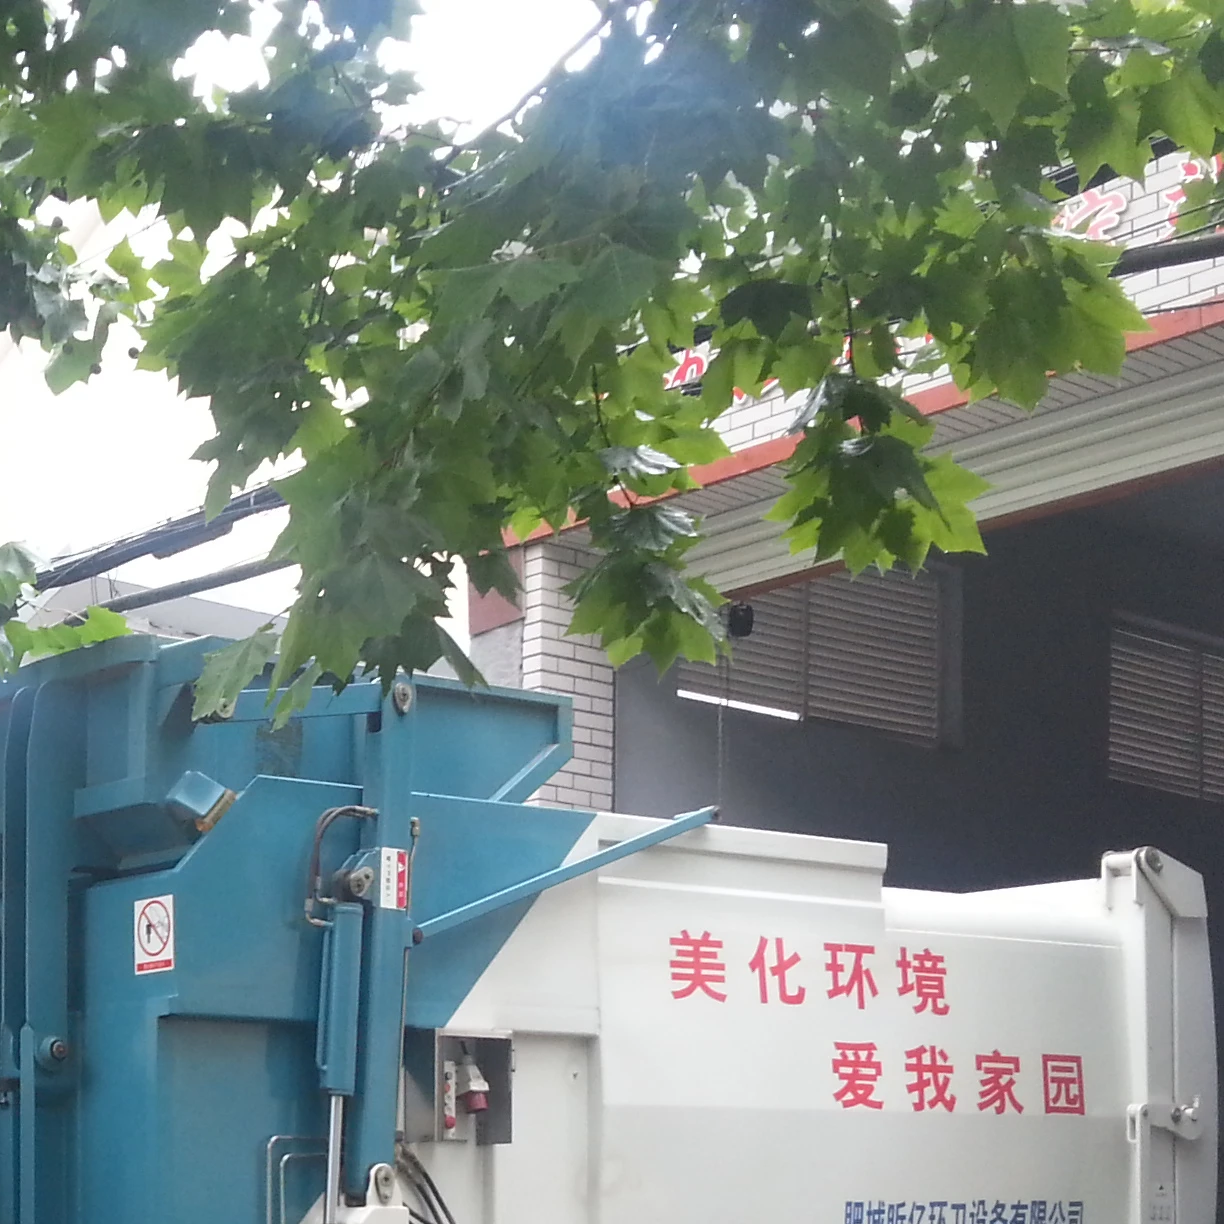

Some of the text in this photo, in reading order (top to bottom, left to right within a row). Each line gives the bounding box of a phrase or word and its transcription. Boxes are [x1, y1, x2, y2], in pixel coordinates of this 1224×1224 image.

[669, 930, 951, 1017] 美化环境
[831, 1041, 1086, 1115] 爱我家园
